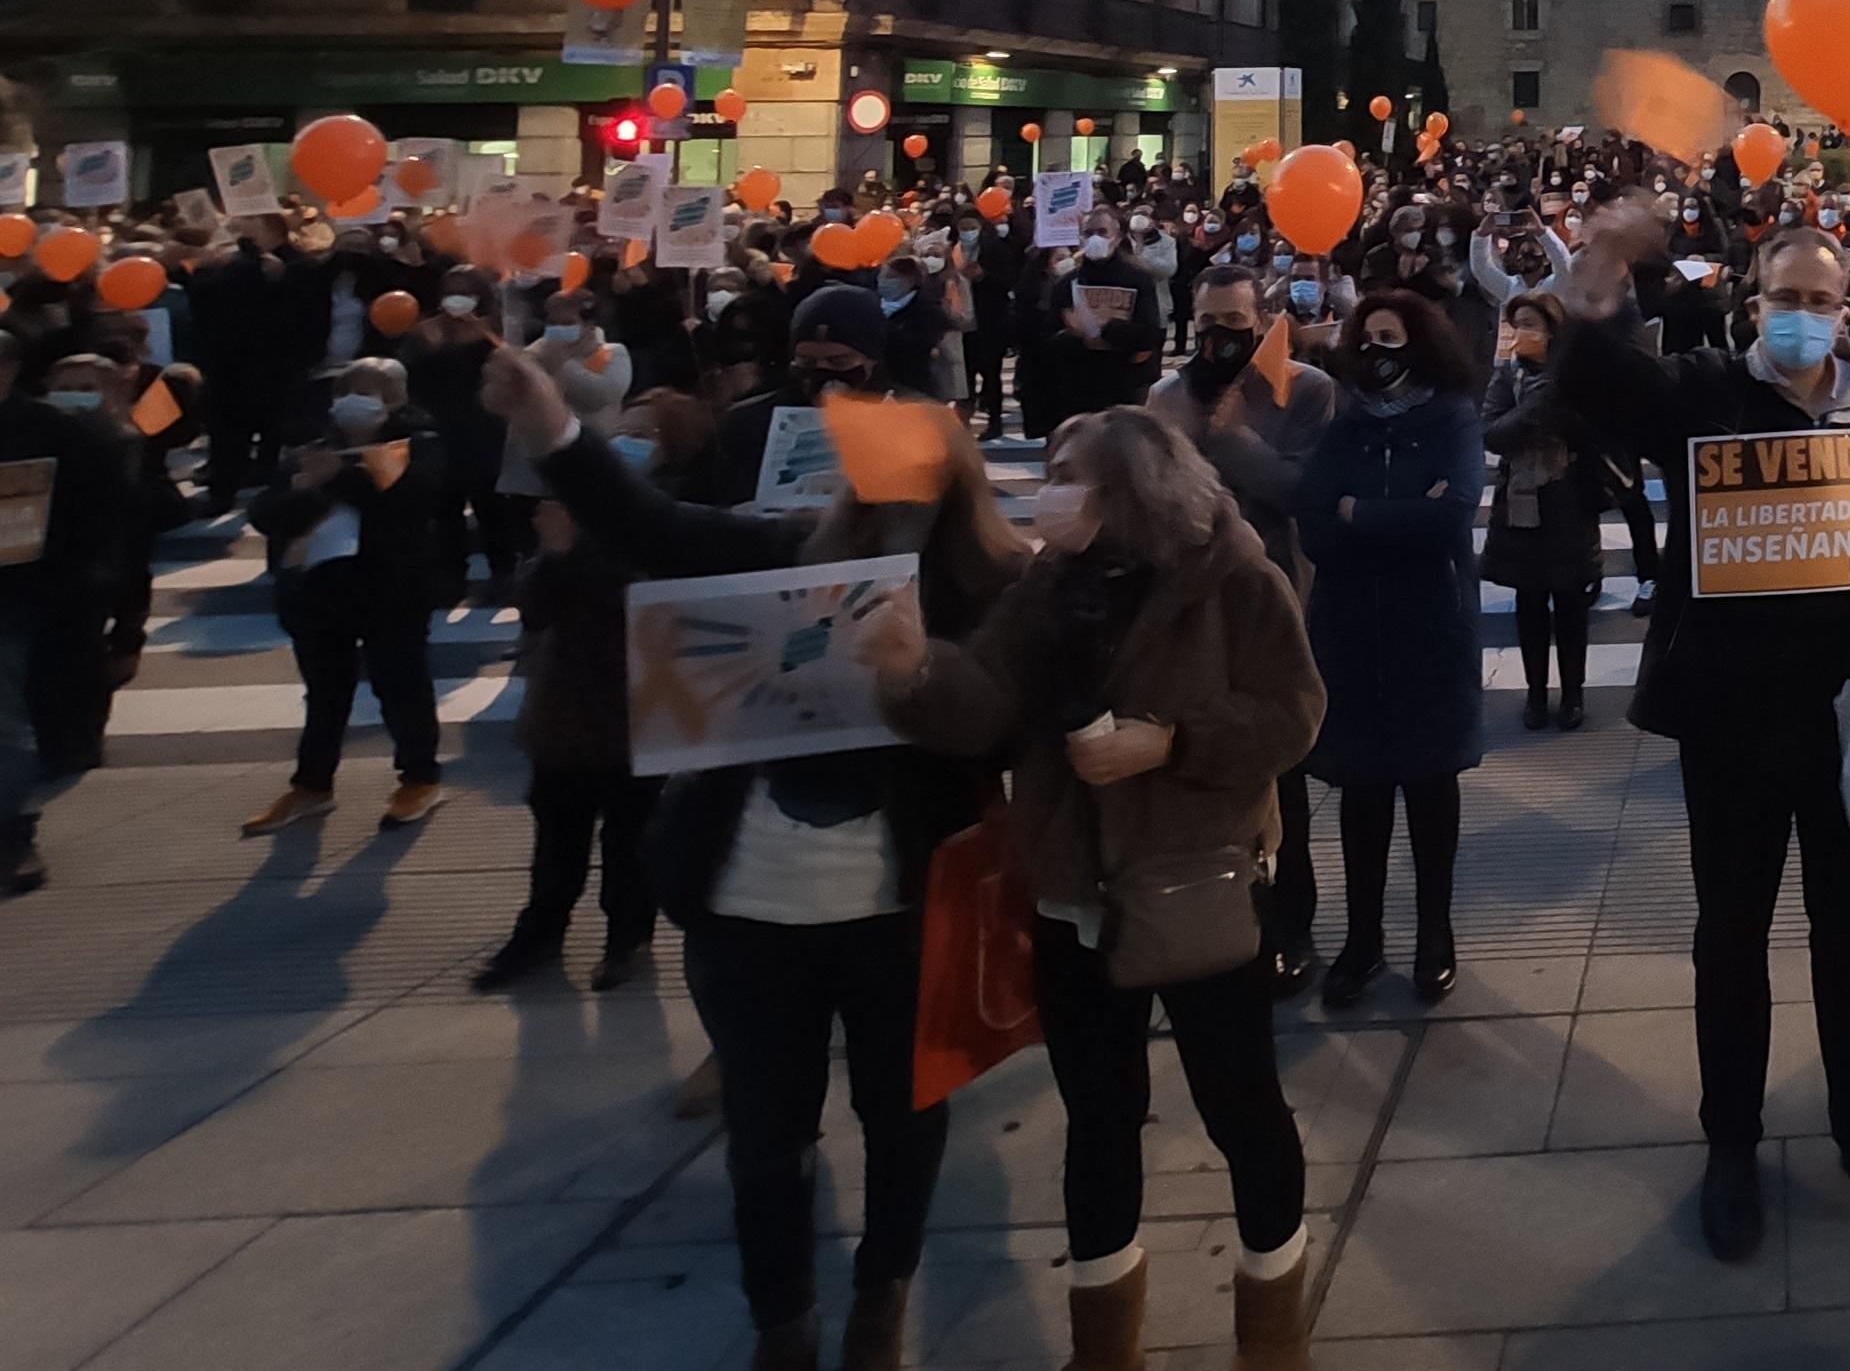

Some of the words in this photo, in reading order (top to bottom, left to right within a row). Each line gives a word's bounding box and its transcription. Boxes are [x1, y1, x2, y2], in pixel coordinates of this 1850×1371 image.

[476, 67, 543, 85] DKV
[904, 72, 943, 84] DKV
[1001, 77, 1026, 91] DKV
[1698, 442, 1744, 487] SE
[1702, 507, 1728, 528] LA
